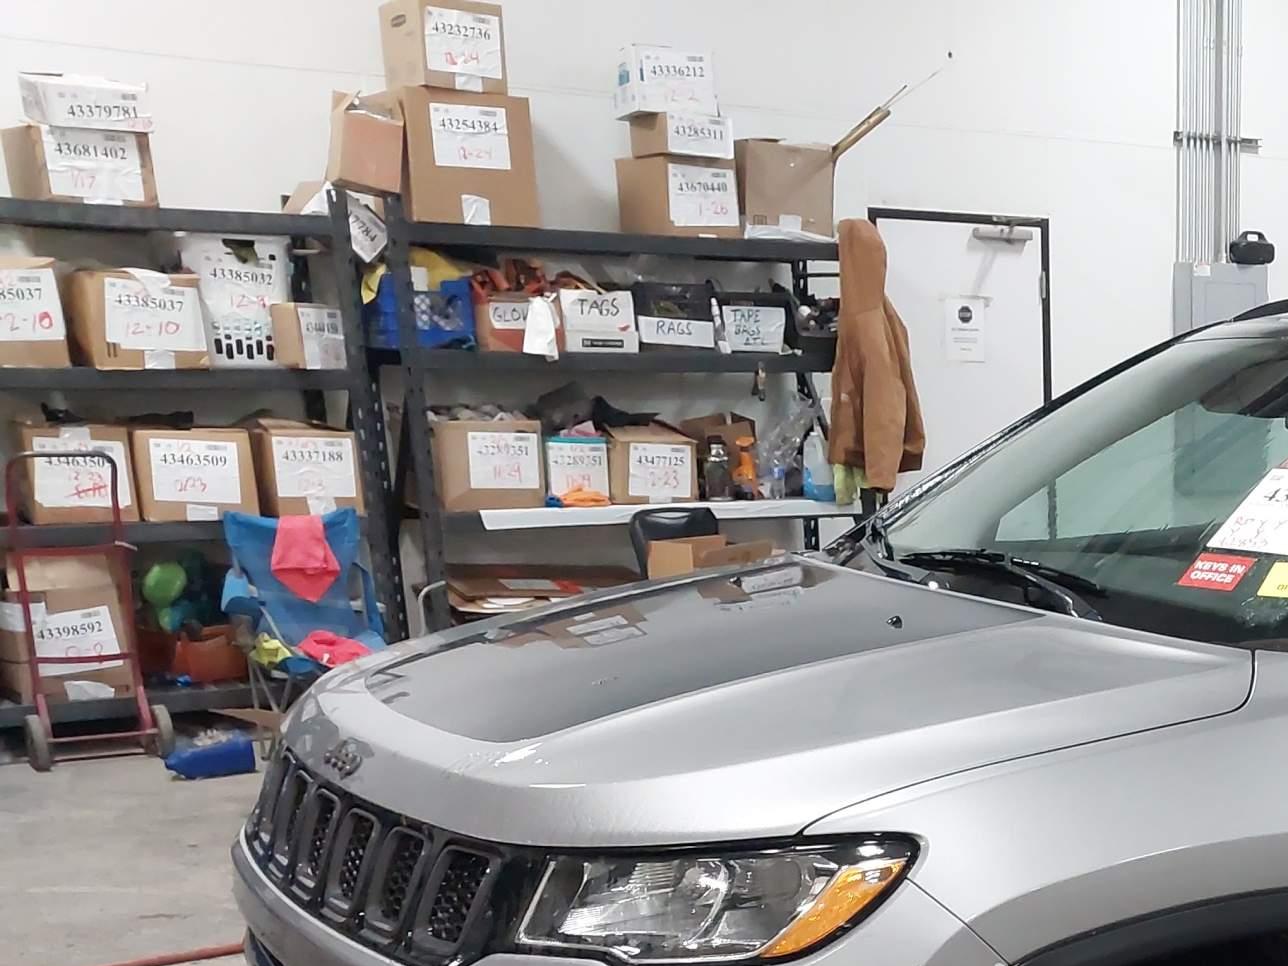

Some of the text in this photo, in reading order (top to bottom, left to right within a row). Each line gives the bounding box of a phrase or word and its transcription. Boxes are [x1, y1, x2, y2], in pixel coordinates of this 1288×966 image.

[432, 22, 491, 40] 43232736
[650, 65, 705, 78] 43336212
[67, 104, 138, 119] 43379781
[440, 118, 498, 132] 43254384
[674, 124, 724, 141] 43285311
[55, 142, 127, 160] 43681402
[678, 182, 728, 192] 43670440
[209, 267, 273, 286] 43385032
[114, 293, 184, 313] 43385037
[577, 298, 620, 317] TAGS
[731, 309, 760, 323] TAPE
[656, 319, 692, 336] RAGS
[734, 324, 761, 337] BAGS
[160, 453, 227, 467] 43463509
[282, 450, 343, 462] 43337188
[637, 455, 685, 466] 43477125
[1195, 561, 1246, 574] KEYS IN
[1190, 571, 1235, 583] OFFICE
[39, 621, 103, 640] 43398592
